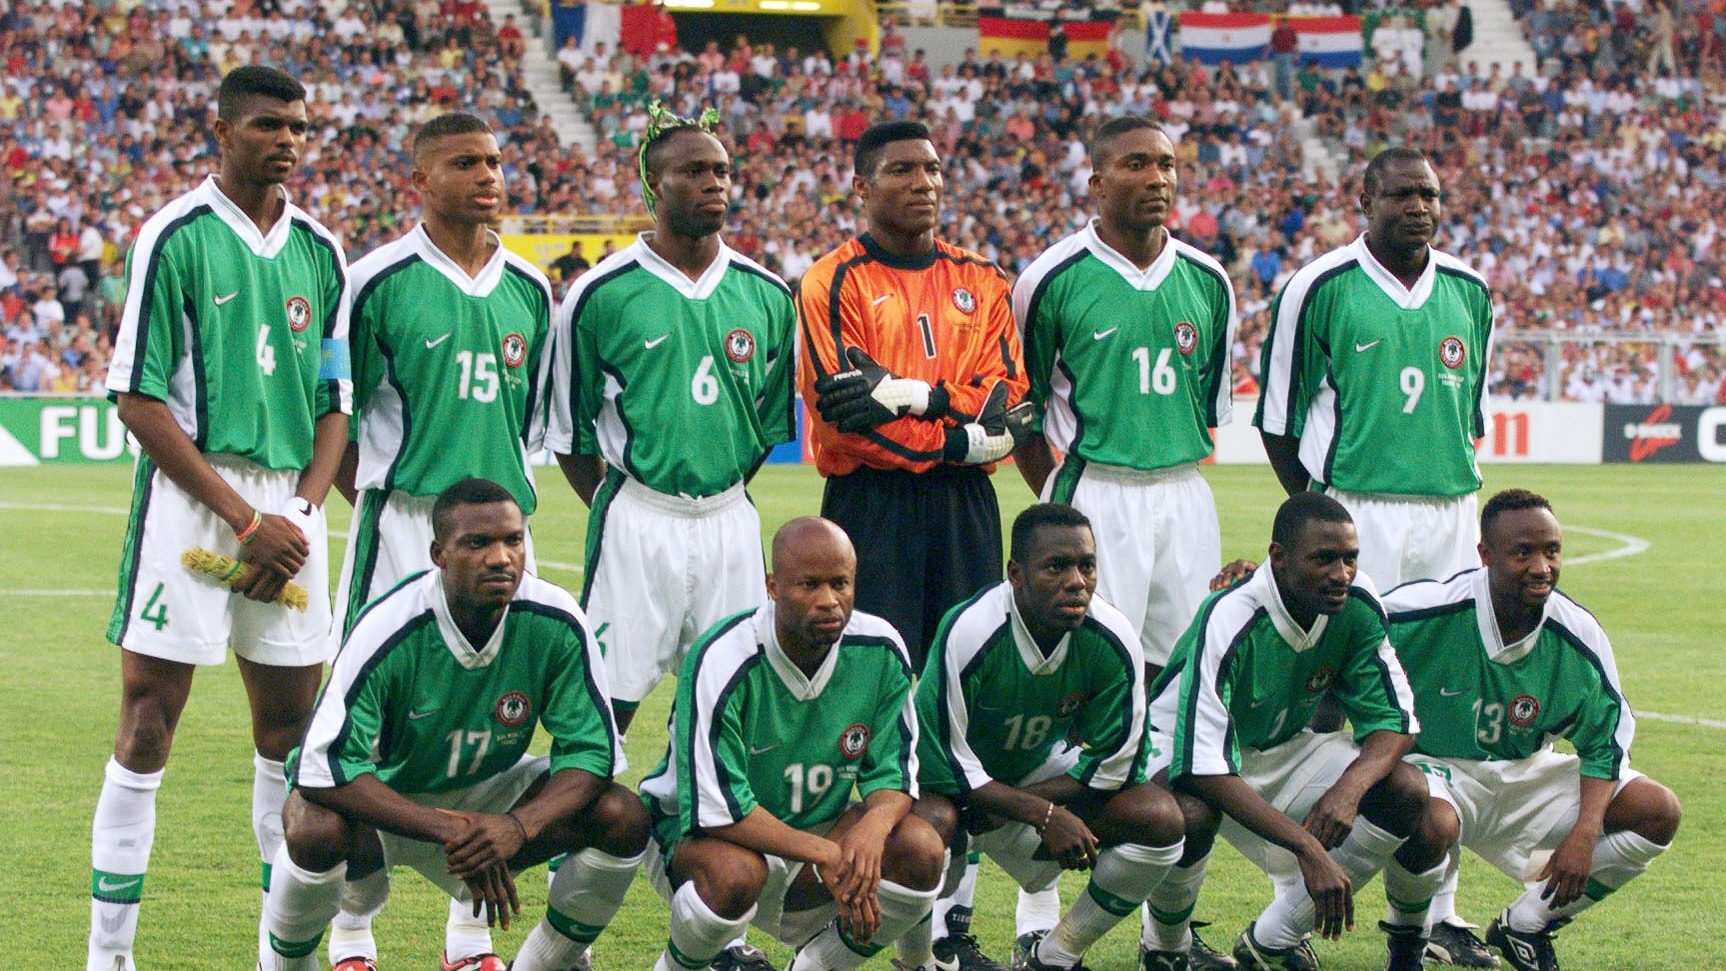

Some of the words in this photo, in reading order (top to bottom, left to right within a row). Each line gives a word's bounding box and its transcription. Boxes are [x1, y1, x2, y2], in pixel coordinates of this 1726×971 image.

[256, 323, 276, 376] 4
[917, 313, 937, 360] 1
[456, 350, 499, 403] 15
[691, 355, 719, 405] 6
[1132, 347, 1176, 395] 16
[1400, 366, 1424, 414] 9
[41, 406, 138, 460] FU
[140, 582, 168, 631] 4
[1004, 714, 1052, 751] 18
[1472, 699, 1504, 744] 13
[445, 729, 492, 778] 17
[784, 763, 833, 814] 19
